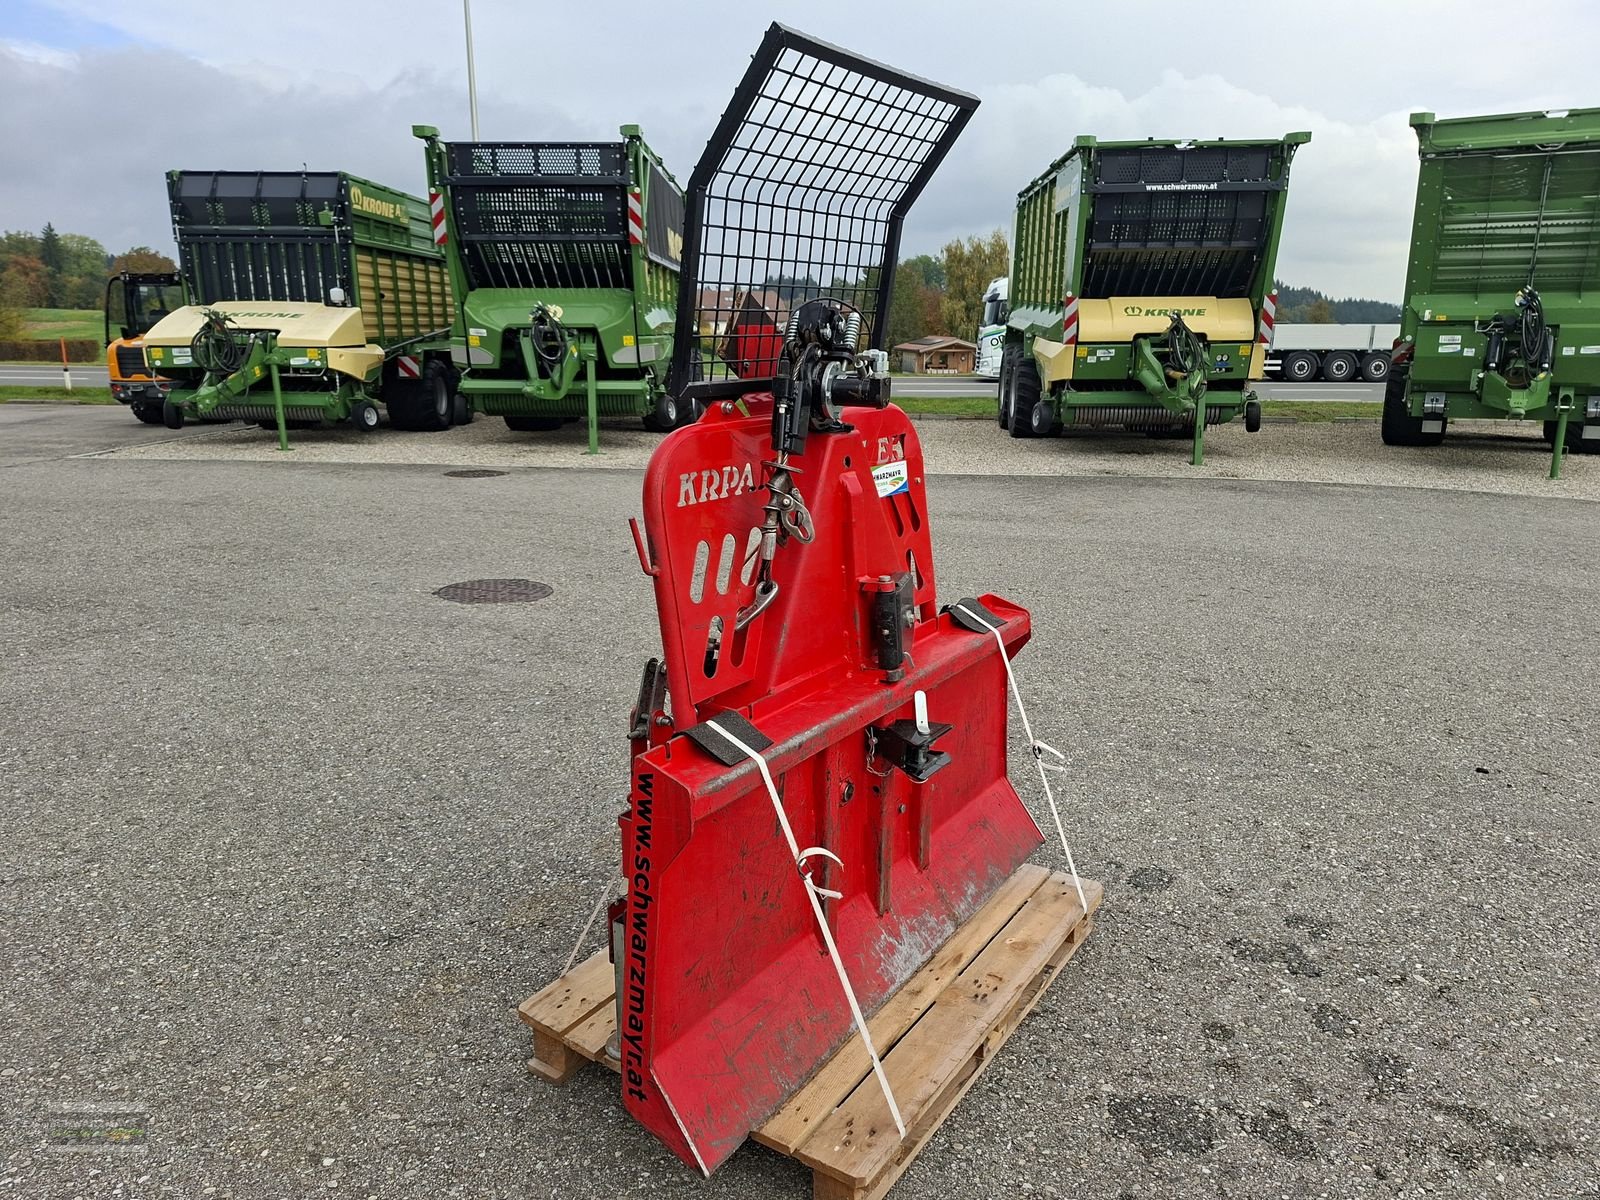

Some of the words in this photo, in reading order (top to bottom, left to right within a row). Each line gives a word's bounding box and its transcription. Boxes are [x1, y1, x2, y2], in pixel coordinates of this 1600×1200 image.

[1145, 182, 1218, 191] www.schwarzmayr.at
[362, 195, 395, 219] KRONE
[622, 772, 654, 1103] www.schwarzmayr.at
